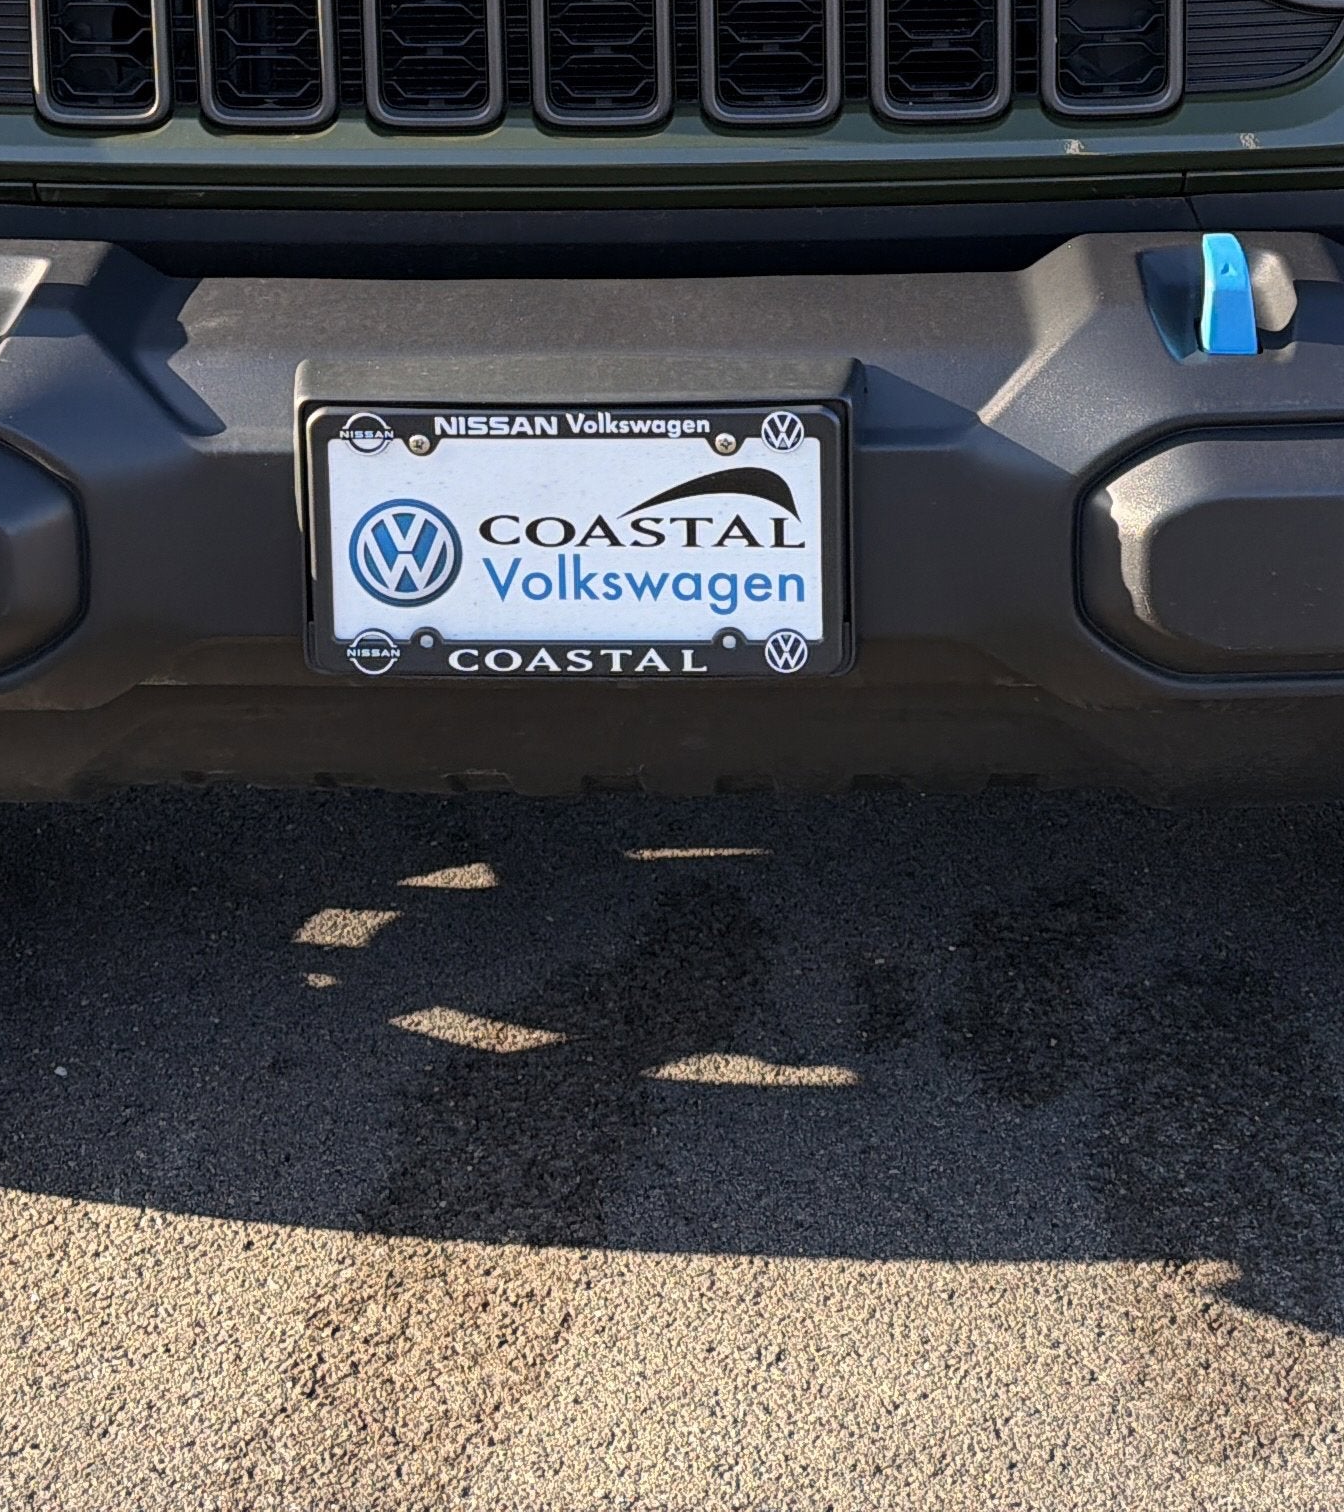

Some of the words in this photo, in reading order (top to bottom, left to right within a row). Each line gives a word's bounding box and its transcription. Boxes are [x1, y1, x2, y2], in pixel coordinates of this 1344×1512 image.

[339, 430, 394, 440] NISSAN
[434, 415, 558, 436] NISSAN
[564, 412, 711, 437] Volkswagen
[478, 514, 806, 549] COASTAL
[482, 553, 805, 616] Volkswagen
[346, 648, 401, 658] NISSAN
[448, 647, 708, 672] COASTAL
